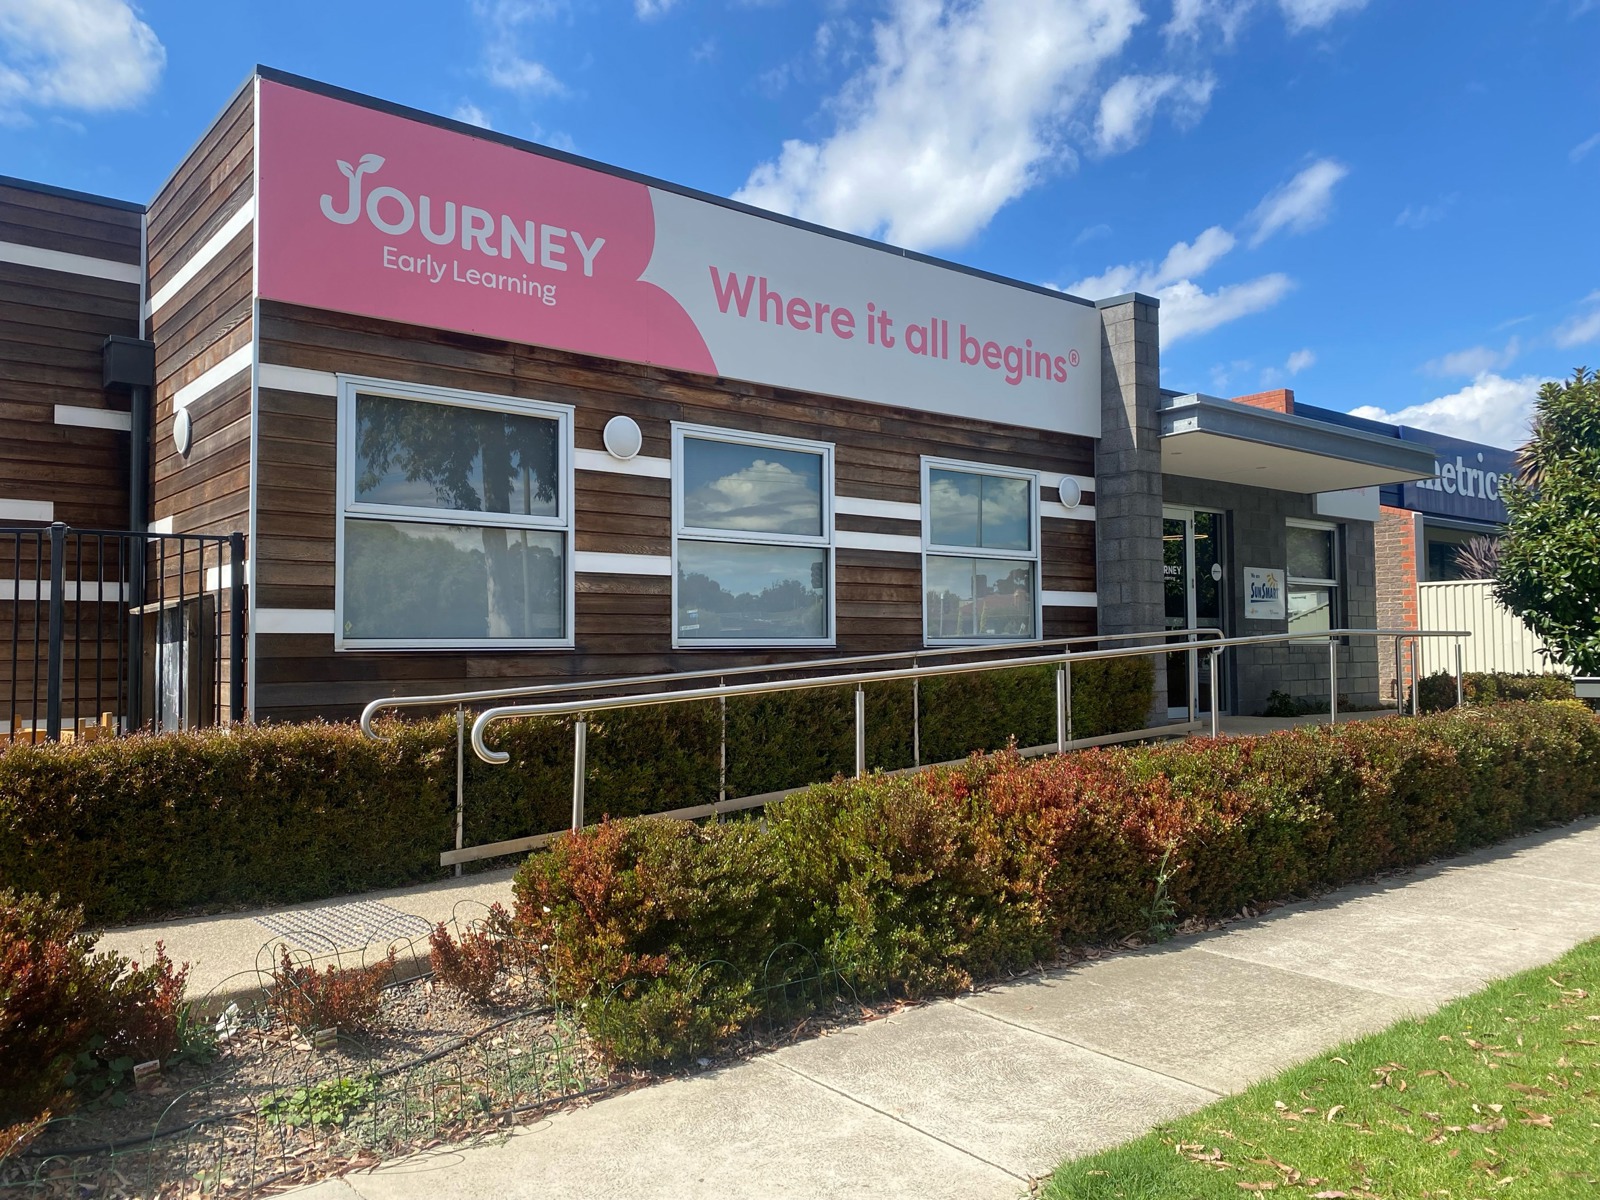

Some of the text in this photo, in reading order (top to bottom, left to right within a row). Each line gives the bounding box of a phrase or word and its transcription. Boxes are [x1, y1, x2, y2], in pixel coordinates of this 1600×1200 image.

[320, 153, 606, 276] JOURNEY
[383, 245, 557, 306] Early Learning
[708, 265, 856, 340] Where
[866, 302, 896, 349] it
[904, 317, 949, 360] all
